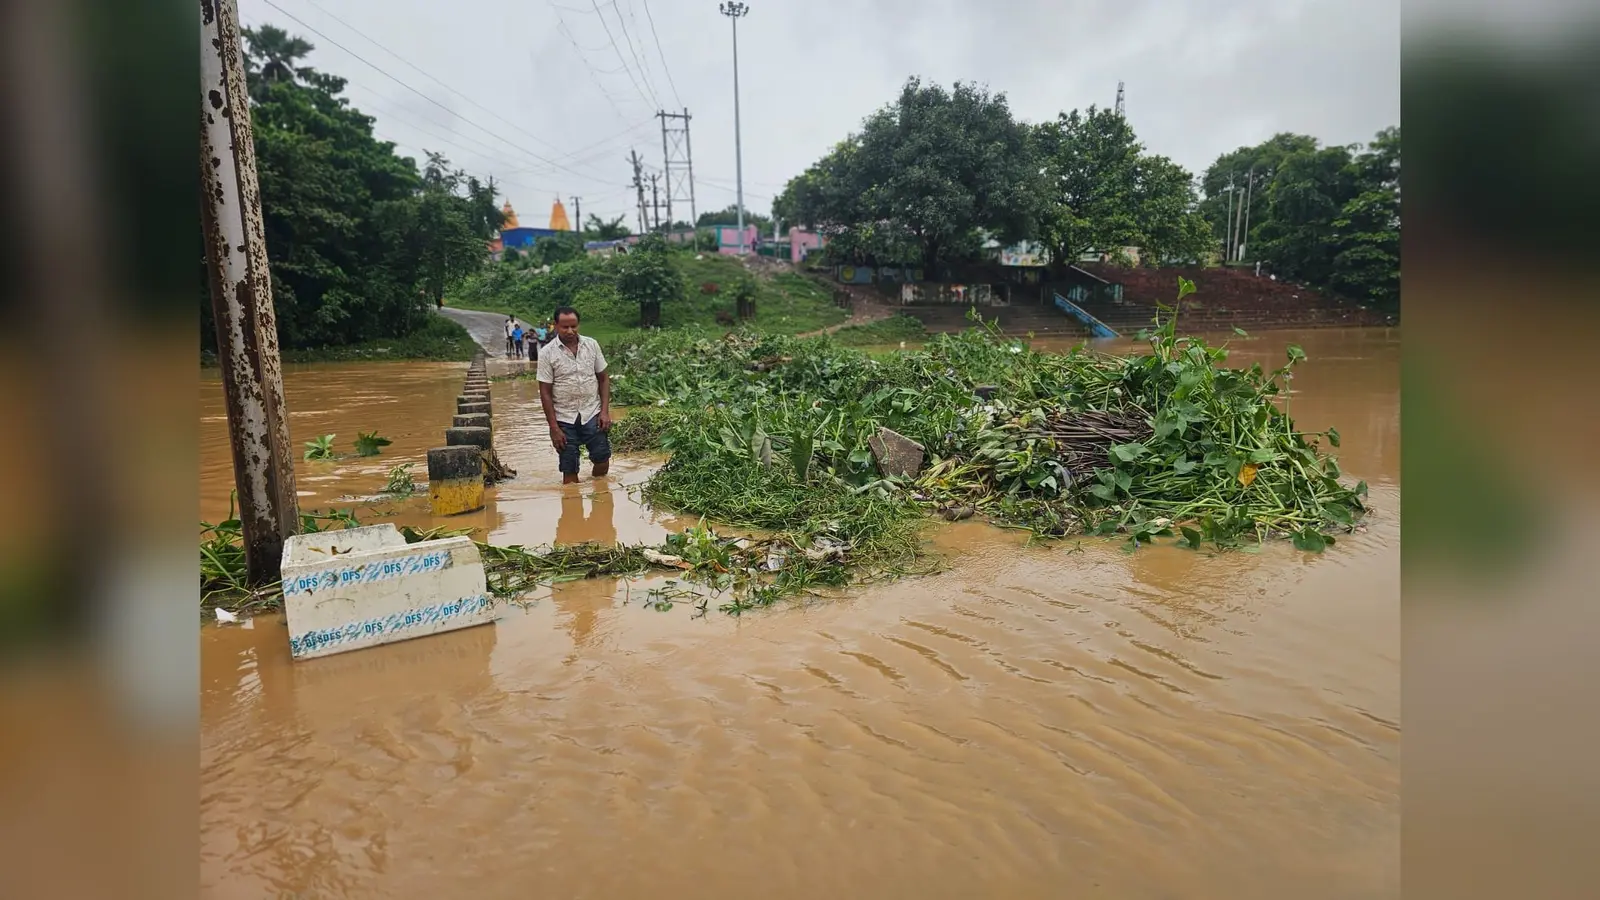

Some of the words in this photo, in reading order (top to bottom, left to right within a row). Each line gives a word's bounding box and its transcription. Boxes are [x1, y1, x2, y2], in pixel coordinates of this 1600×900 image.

[299, 577, 318, 589] DFS
[342, 570, 361, 582] DFS
[384, 562, 402, 574] DFS
[423, 556, 440, 567] DFS
[365, 622, 383, 634] DFS
[405, 613, 422, 625] DFS
[443, 604, 460, 616] DFS
